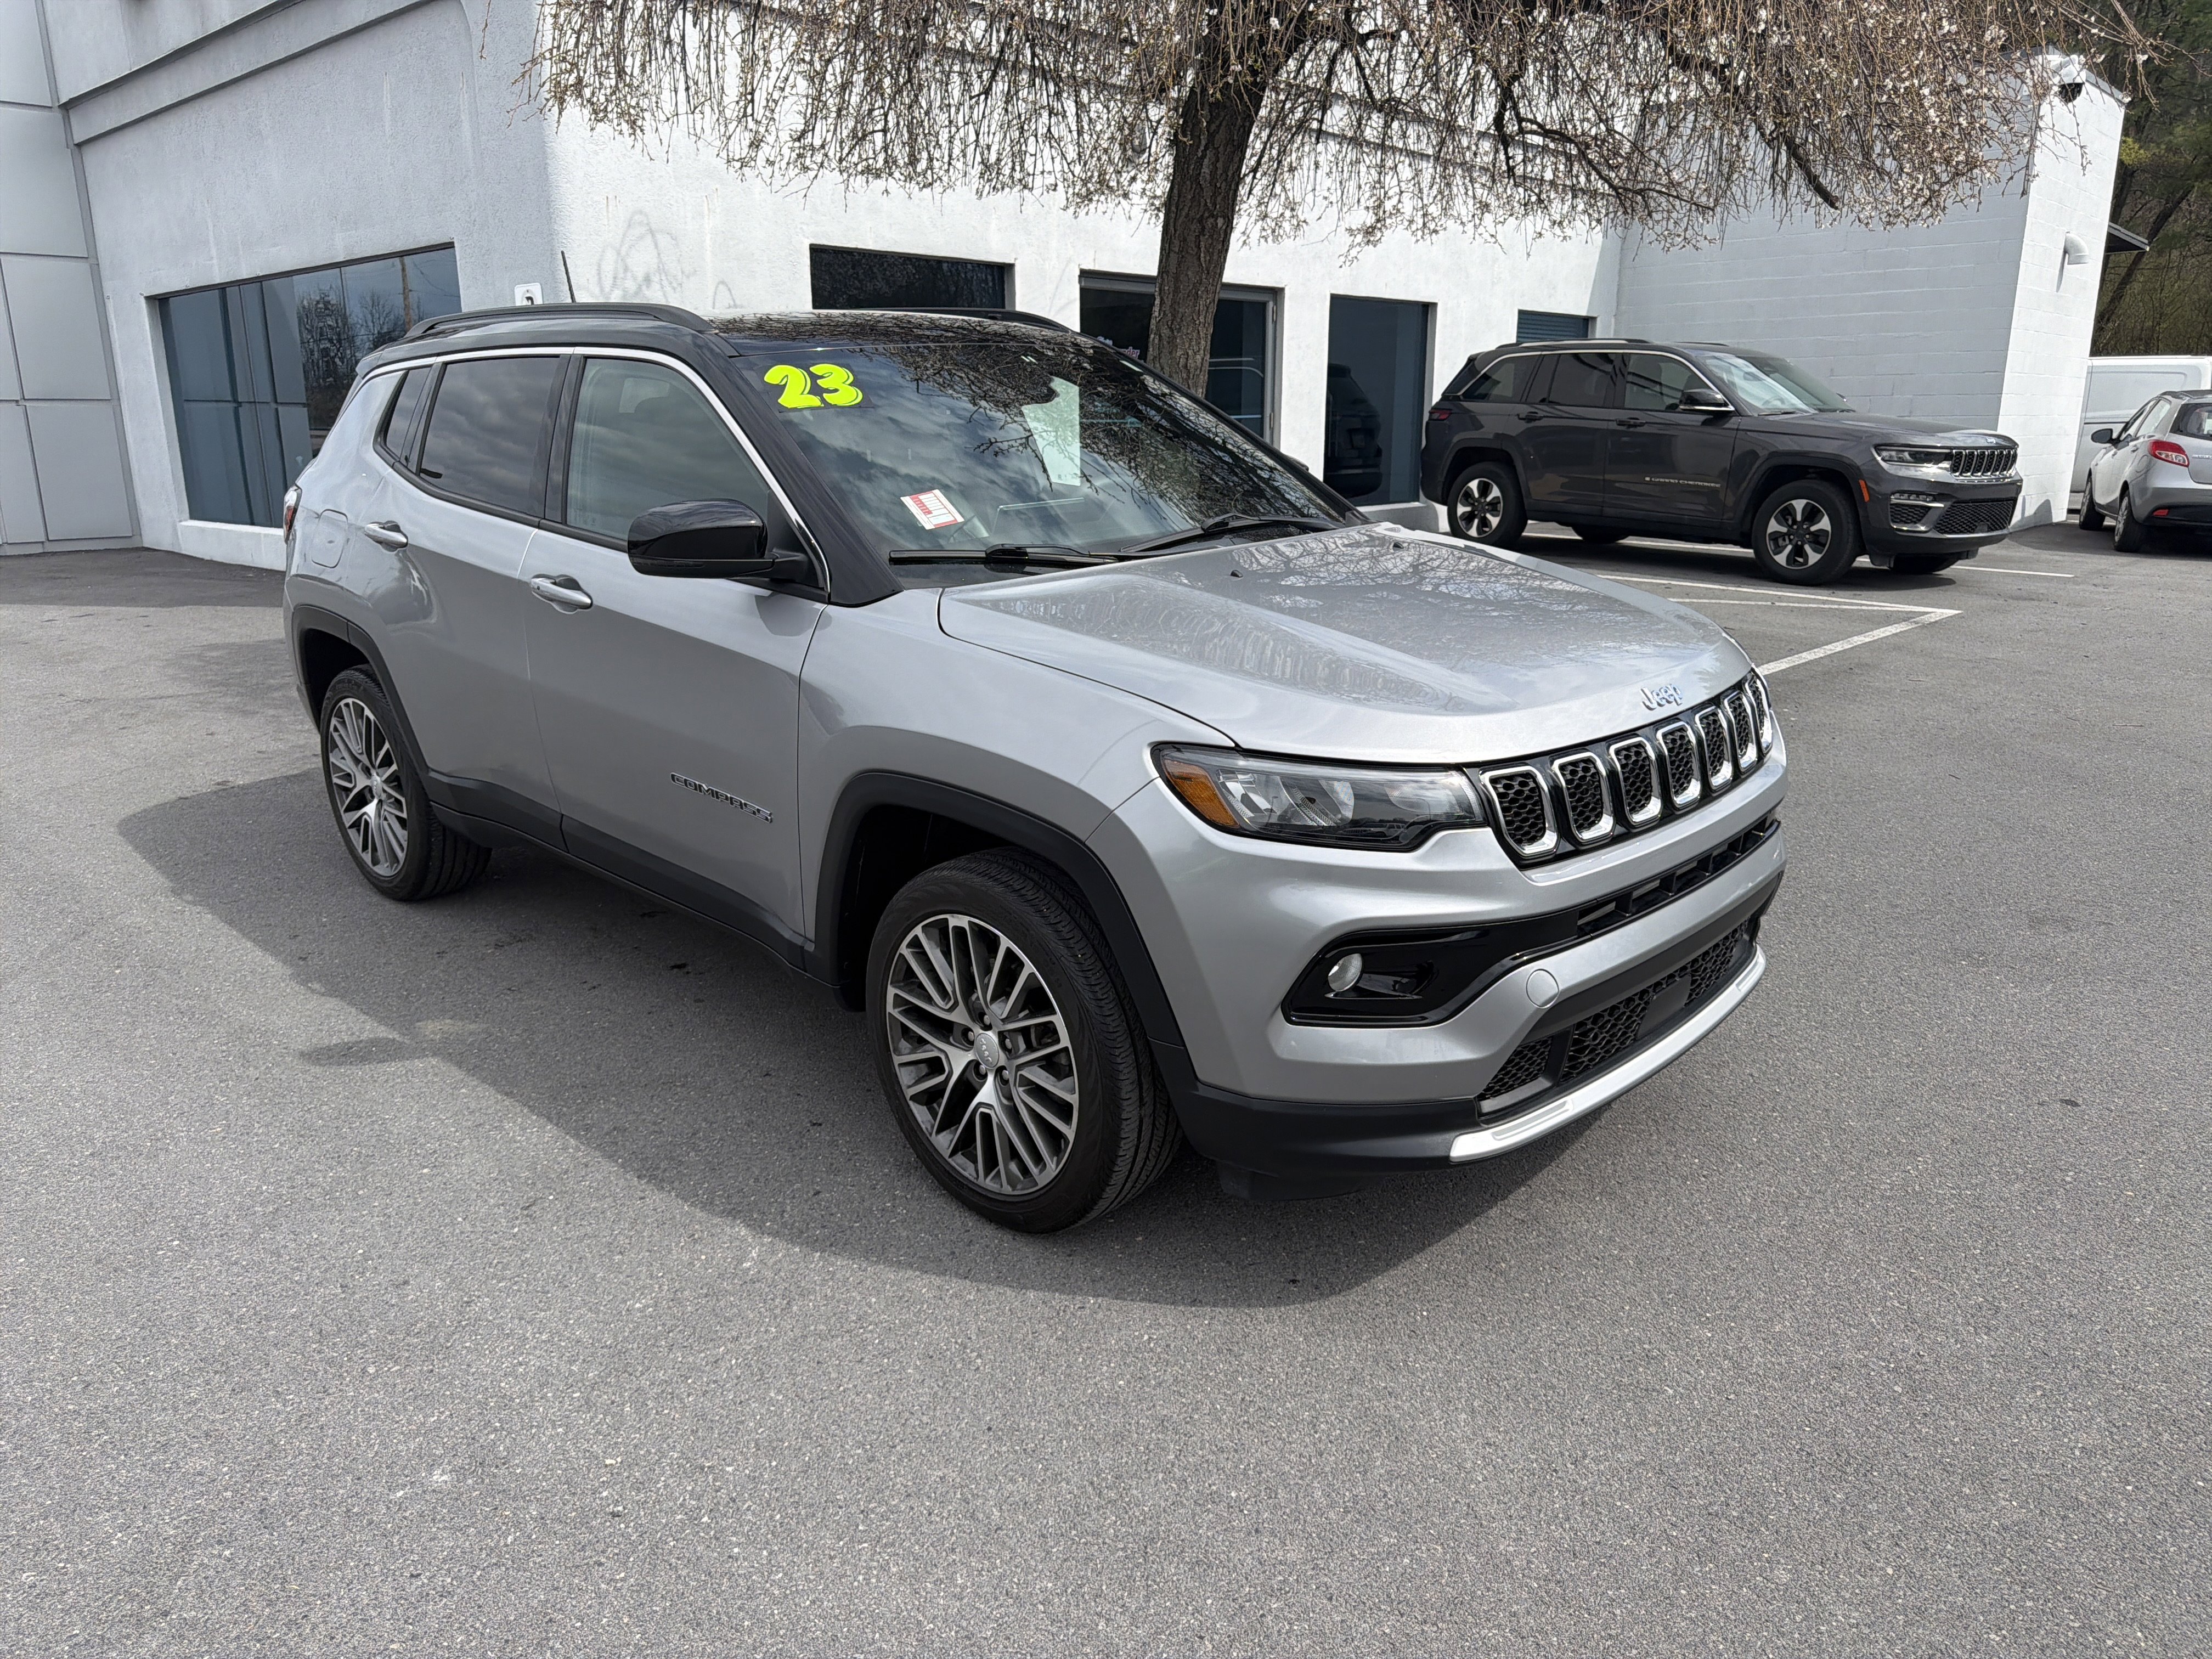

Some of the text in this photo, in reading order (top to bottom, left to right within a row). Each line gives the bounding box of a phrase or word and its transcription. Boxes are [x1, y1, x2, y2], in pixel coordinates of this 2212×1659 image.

[764, 364, 863, 409] 23
[1640, 684, 1683, 711] Jeep
[670, 772, 773, 823] COMPASS
